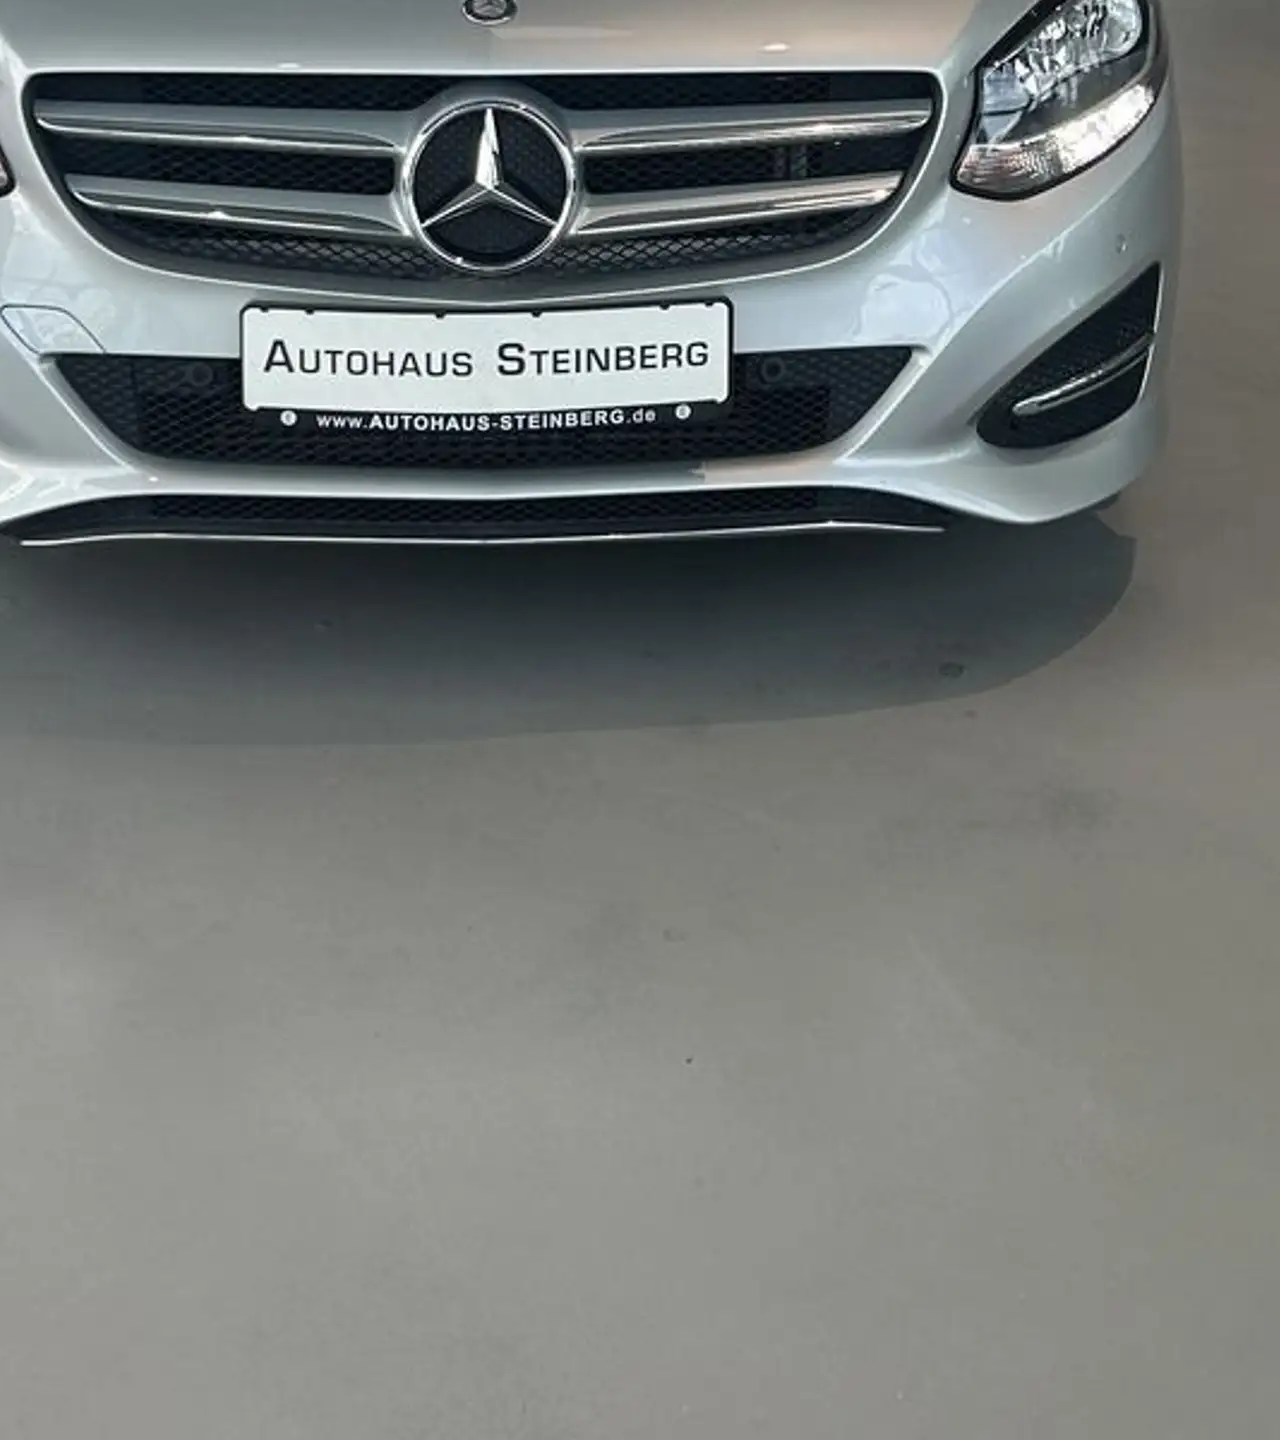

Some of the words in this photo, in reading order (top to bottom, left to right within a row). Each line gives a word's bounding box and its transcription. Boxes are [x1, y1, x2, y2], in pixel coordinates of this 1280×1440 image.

[263, 339, 473, 378] AUTOHAUS
[497, 341, 709, 376] STEINBERG
[316, 409, 656, 432] www.AUTOHAUS-STEINBERG.de
